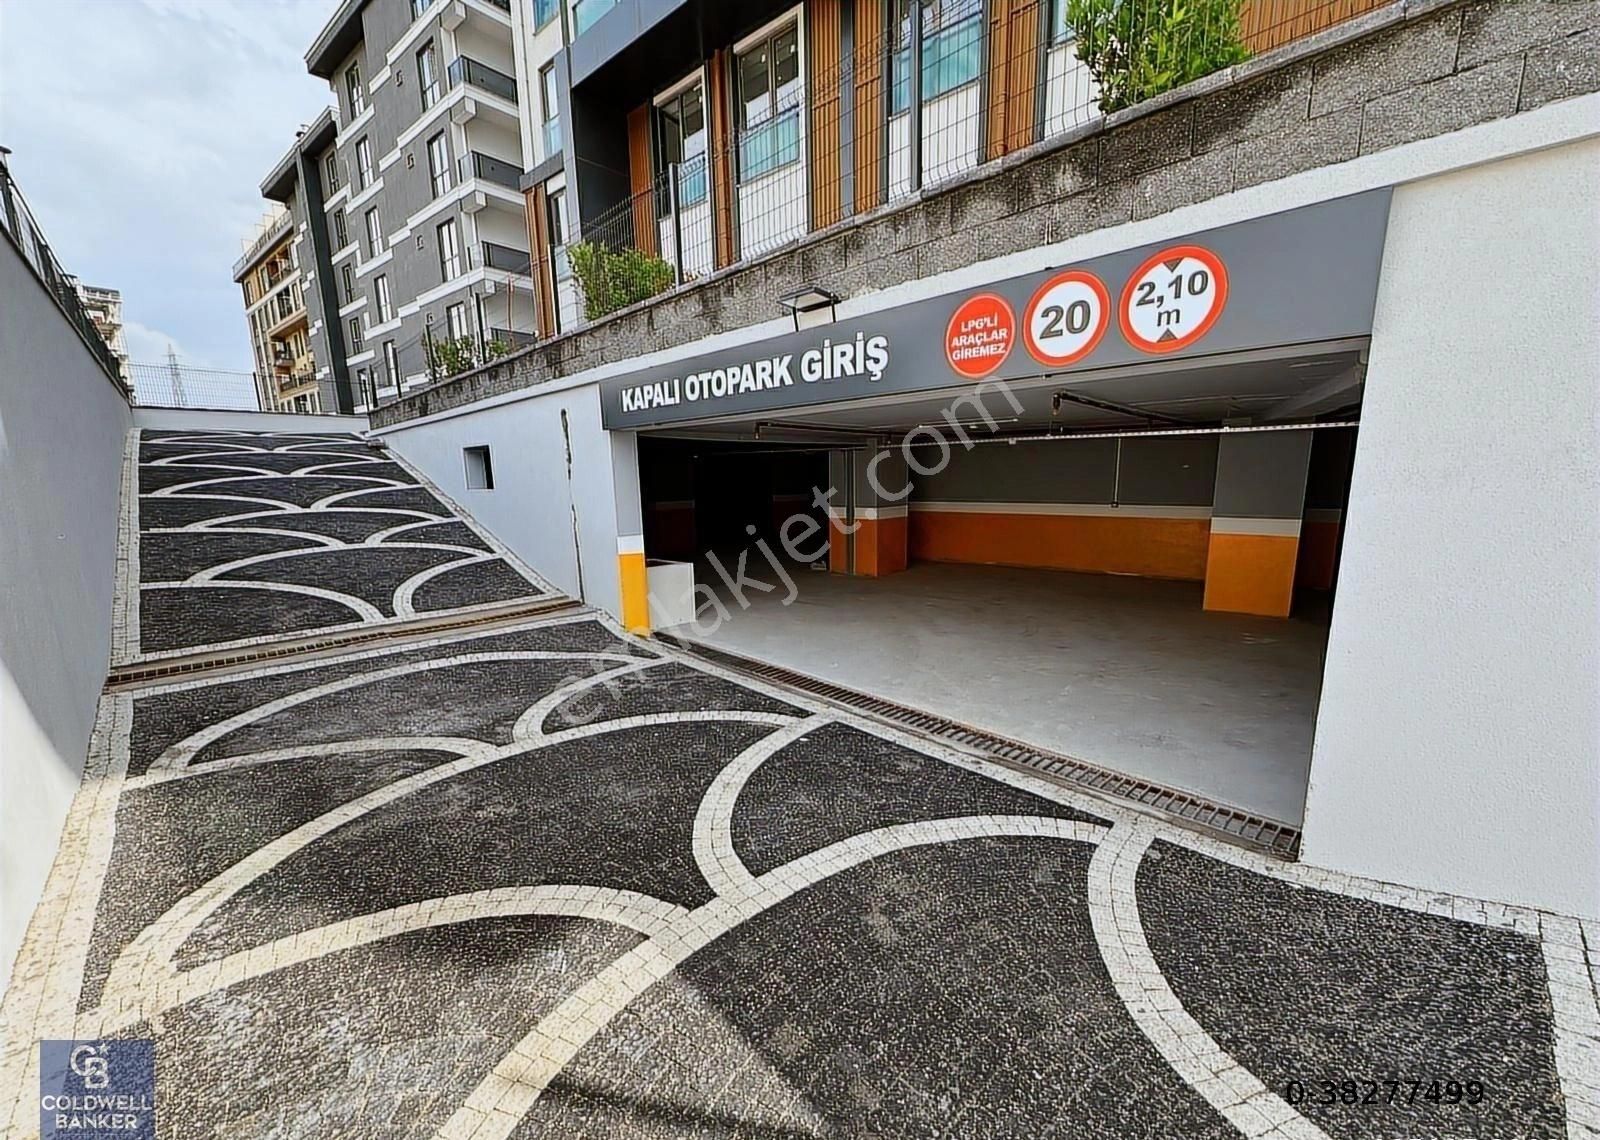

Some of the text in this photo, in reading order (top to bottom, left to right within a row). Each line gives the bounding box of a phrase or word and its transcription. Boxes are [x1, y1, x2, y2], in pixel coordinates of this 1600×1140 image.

[1136, 270, 1209, 308] 2,10
[961, 313, 998, 333] LPG'Lİ
[1039, 300, 1091, 340] 20
[1157, 308, 1181, 327] m
[952, 328, 1008, 347] ARAÇLAR
[952, 342, 1006, 361] GİREMEZ
[621, 331, 889, 412] KAPALI OTOPARK GİRİŞ
